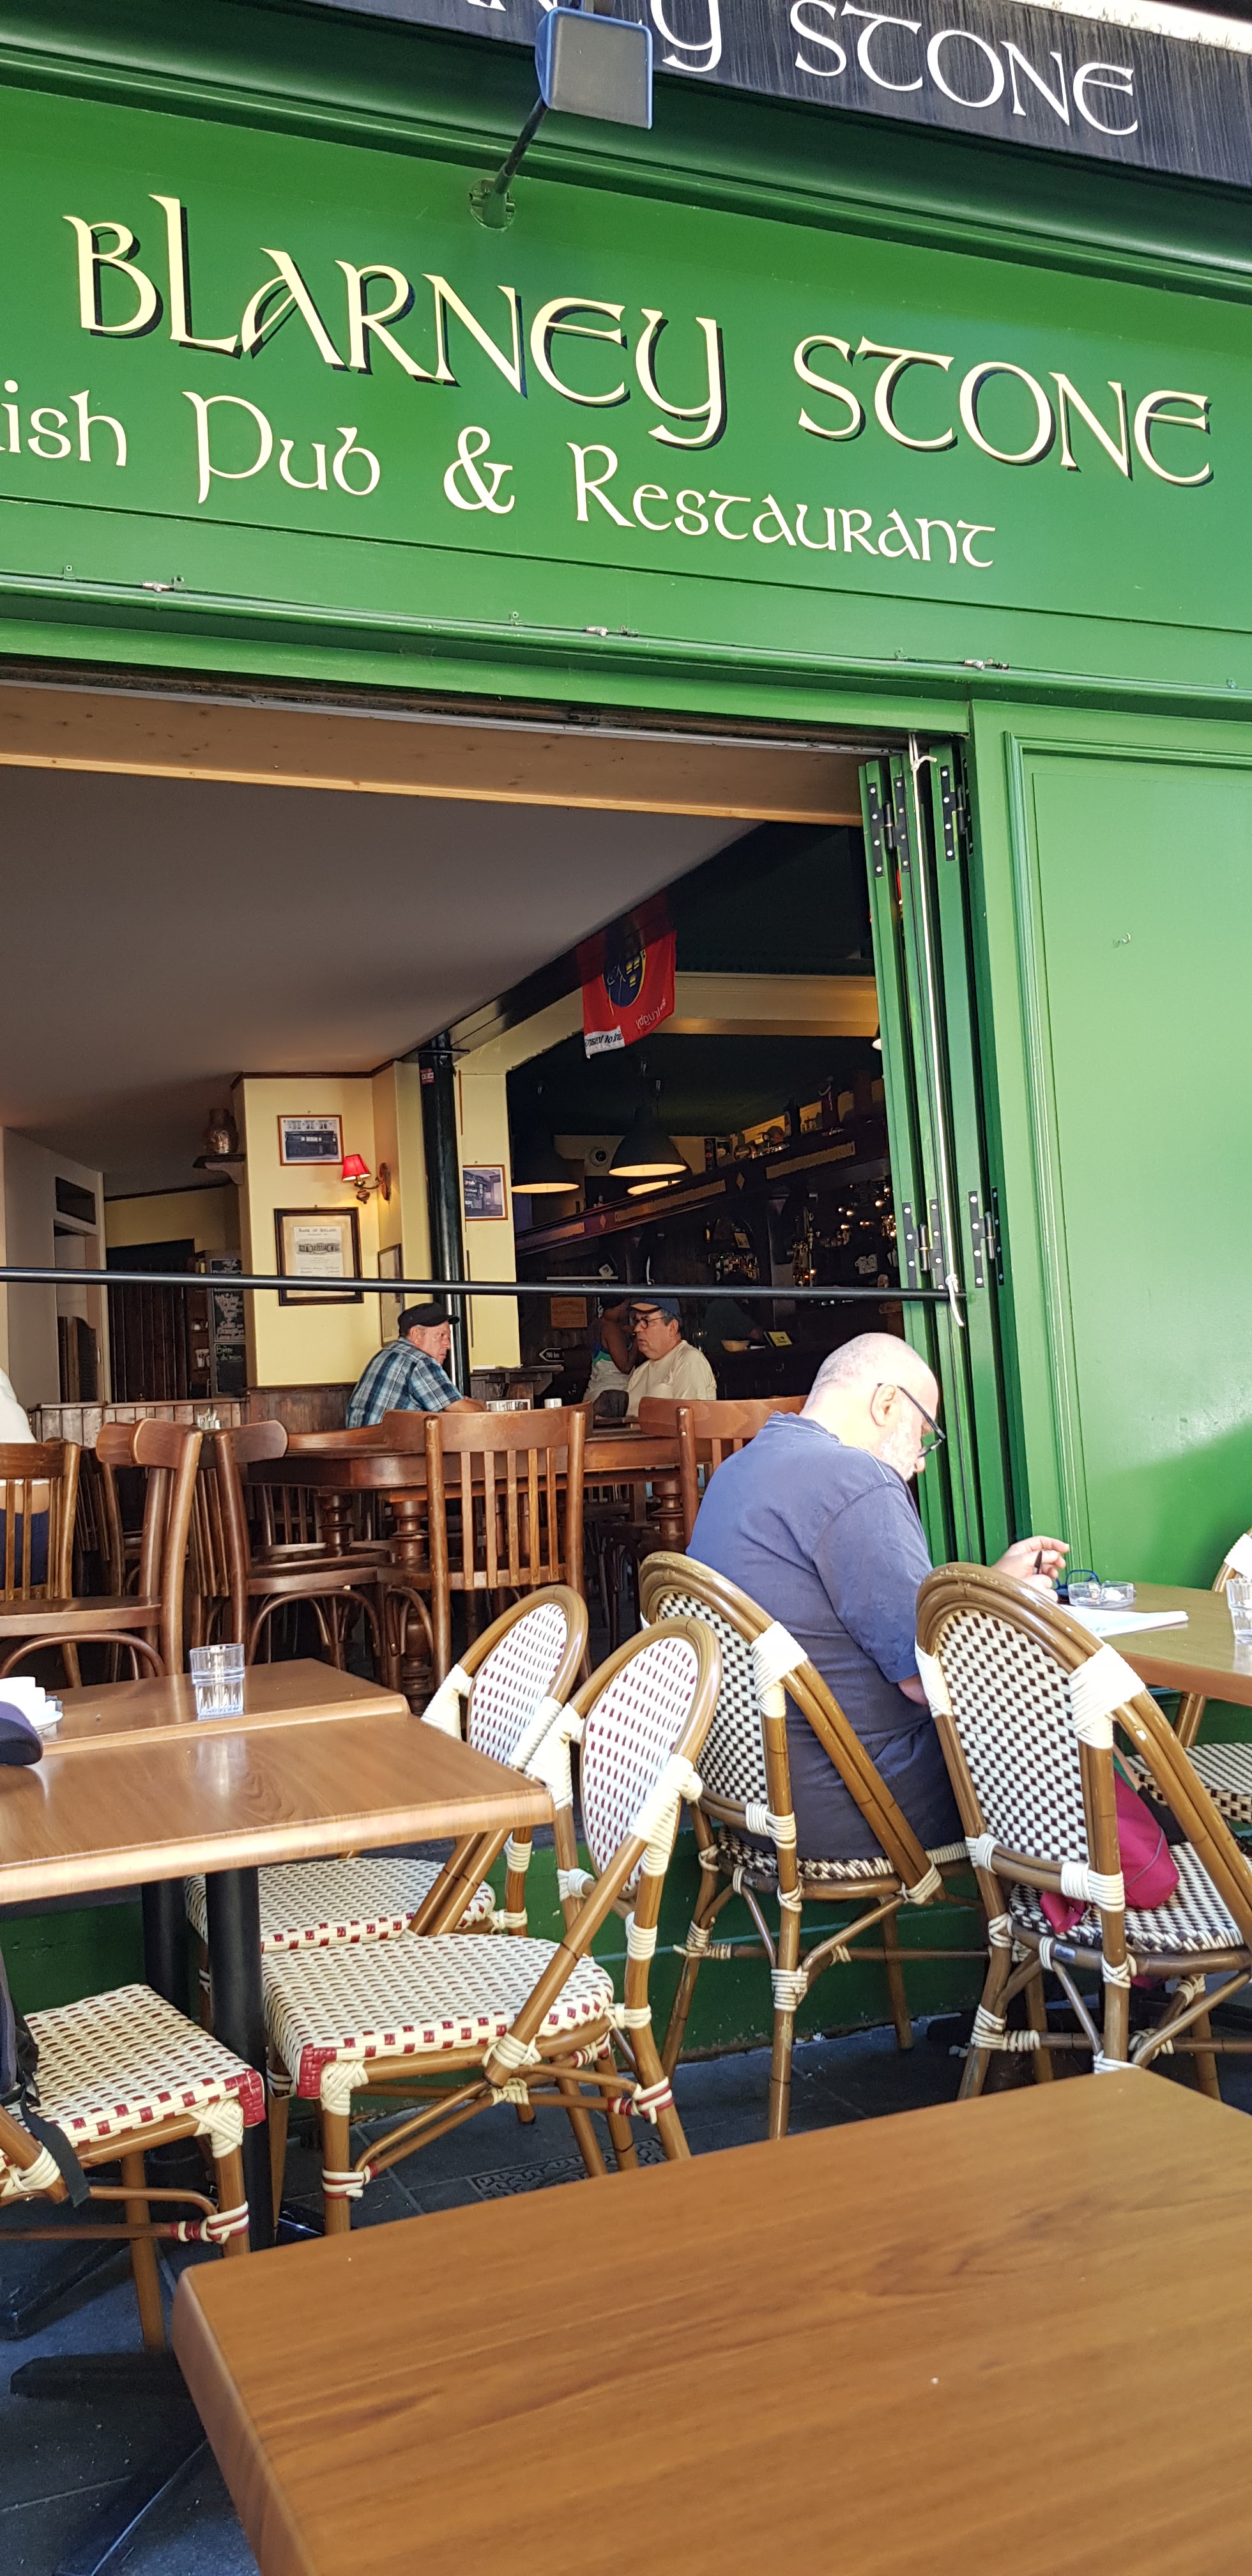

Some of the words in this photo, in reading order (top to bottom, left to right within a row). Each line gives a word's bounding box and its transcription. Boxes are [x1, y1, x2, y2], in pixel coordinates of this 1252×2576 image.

[790, 0, 1138, 135] STONE
[63, 194, 726, 447] BLARNEY
[793, 335, 1212, 486] STONE
[0, 379, 127, 467] ish
[181, 391, 381, 504] Pub
[443, 426, 515, 514] &
